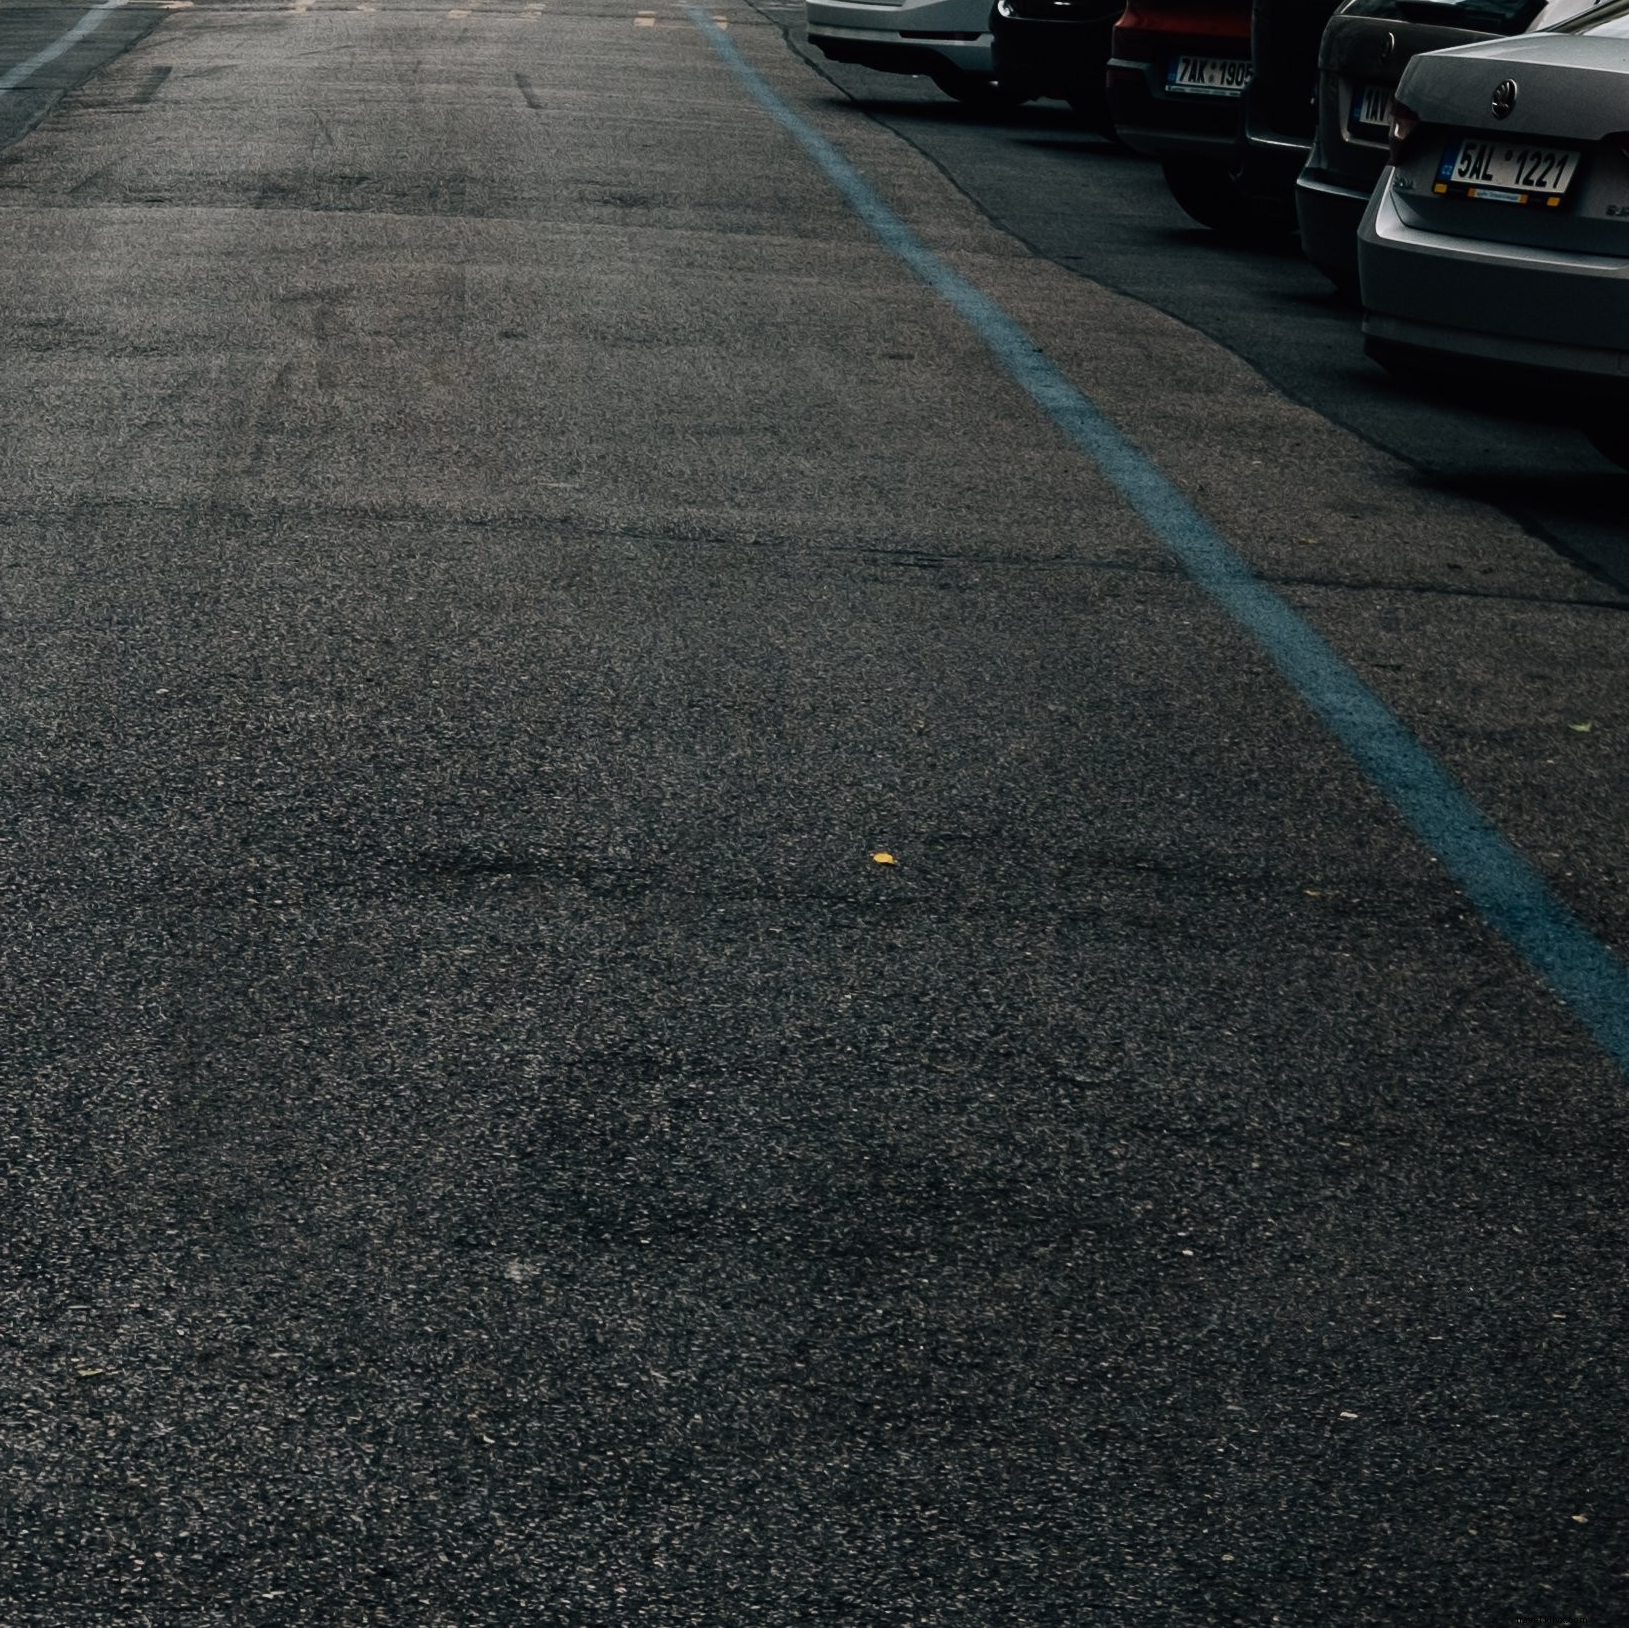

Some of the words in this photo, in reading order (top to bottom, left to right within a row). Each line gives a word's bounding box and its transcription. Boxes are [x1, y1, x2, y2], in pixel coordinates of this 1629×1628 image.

[1179, 57, 1209, 84] 7AK
[1458, 143, 1496, 182] 5AL
[1515, 150, 1568, 189] 1221
